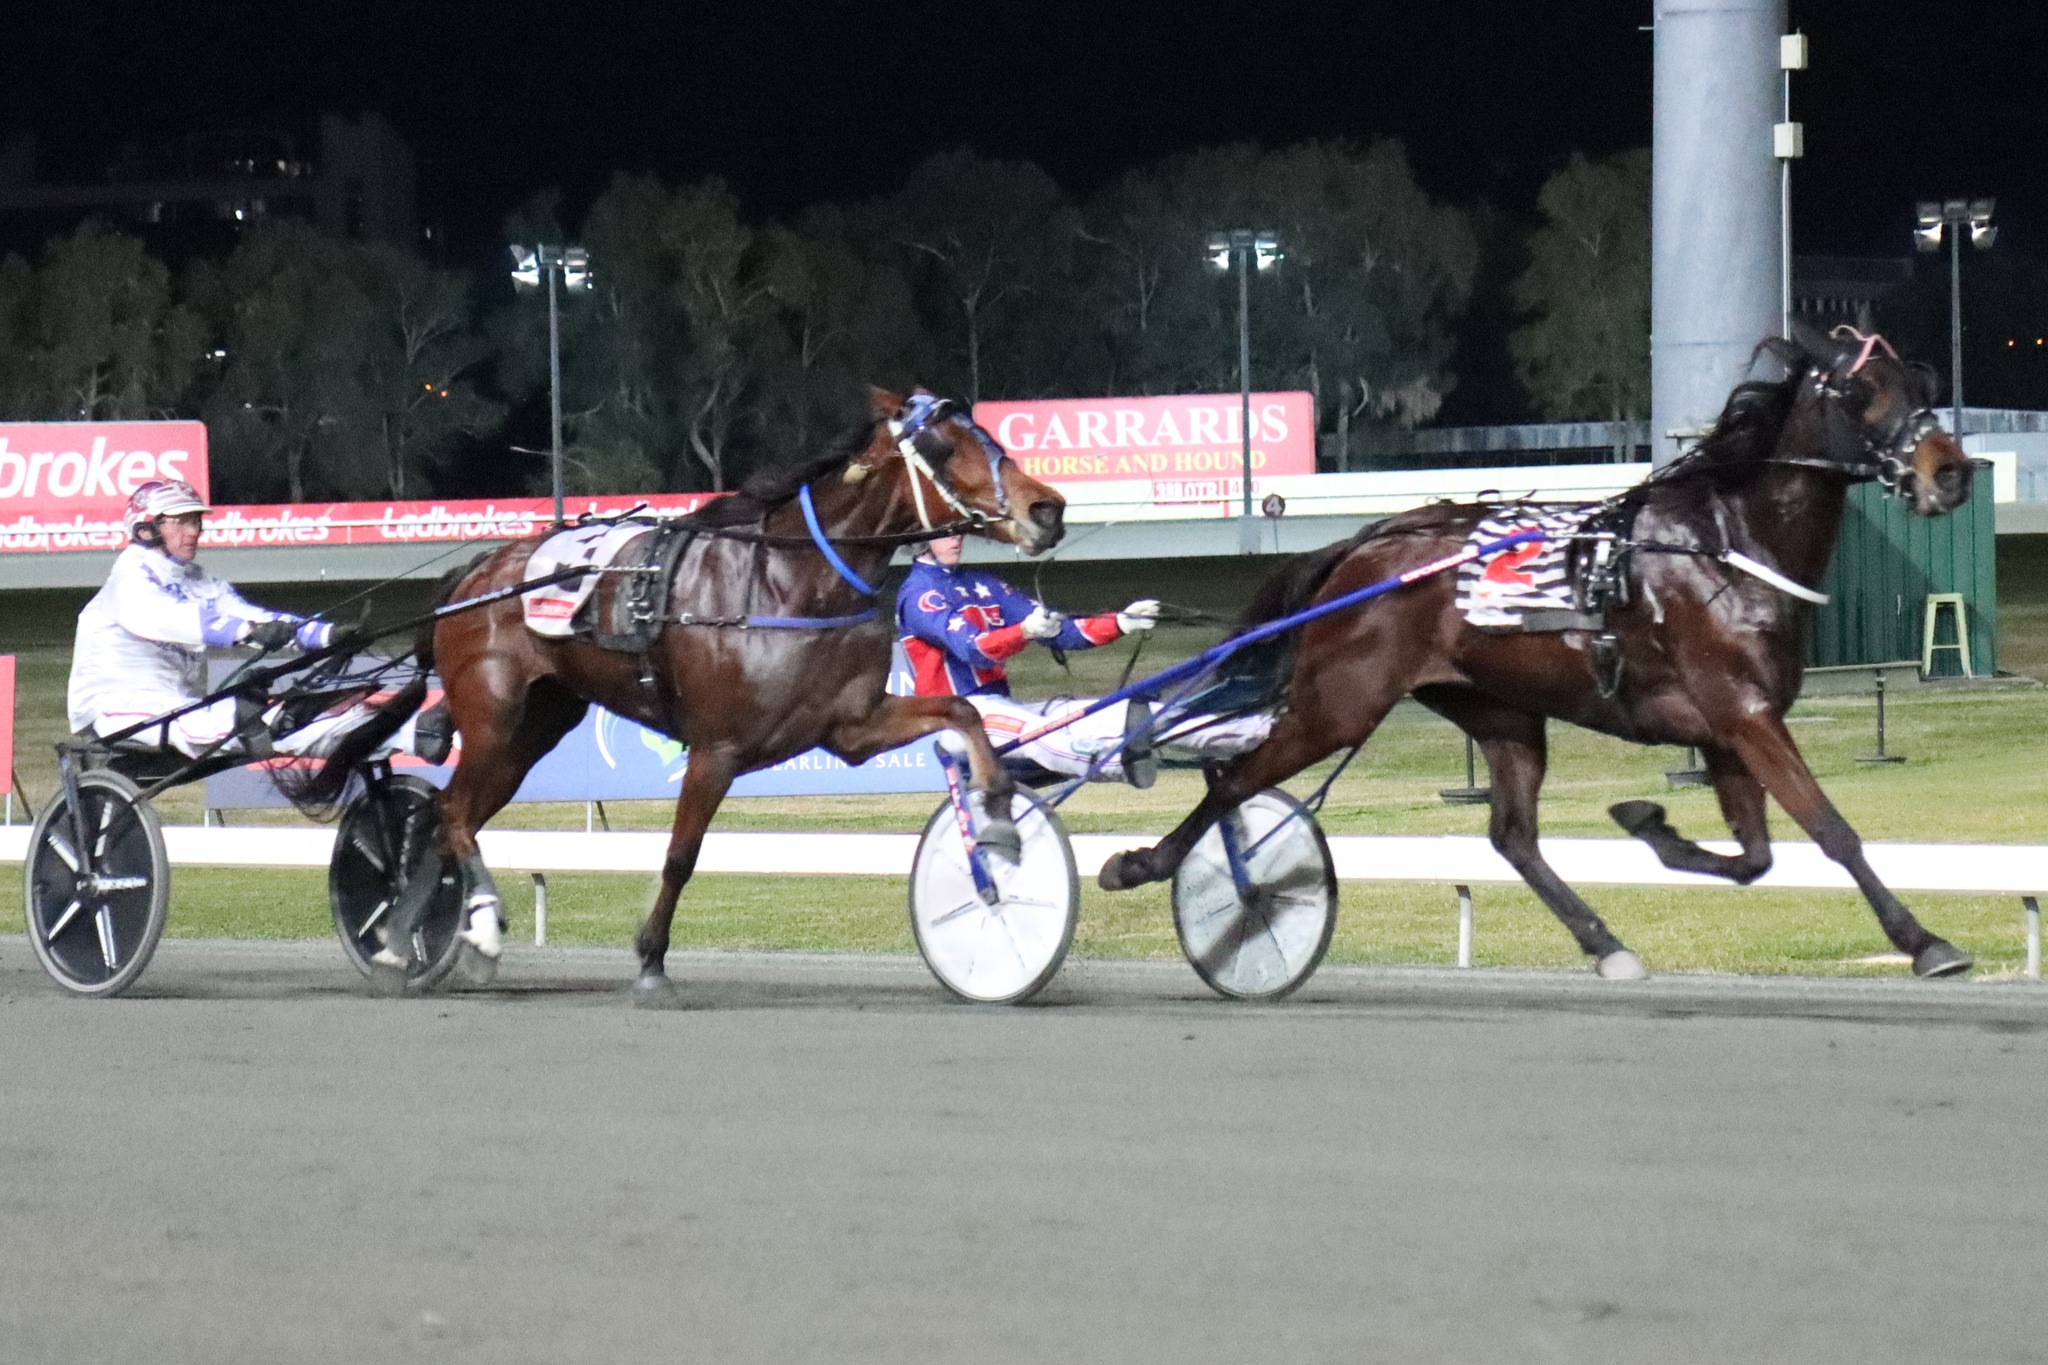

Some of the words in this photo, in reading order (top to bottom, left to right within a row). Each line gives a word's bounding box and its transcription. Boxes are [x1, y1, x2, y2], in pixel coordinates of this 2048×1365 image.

[999, 404, 1288, 450] GARRARDS
[1024, 456, 1109, 476] HORSE
[1115, 453, 1167, 474] AND
[1175, 450, 1266, 472] HOUND
[381, 504, 535, 538] Ladbrokes
[1265, 496, 1281, 515] 4
[0, 514, 125, 549] dbrokes
[1483, 528, 1543, 587] 2
[875, 752, 925, 769] SALE
